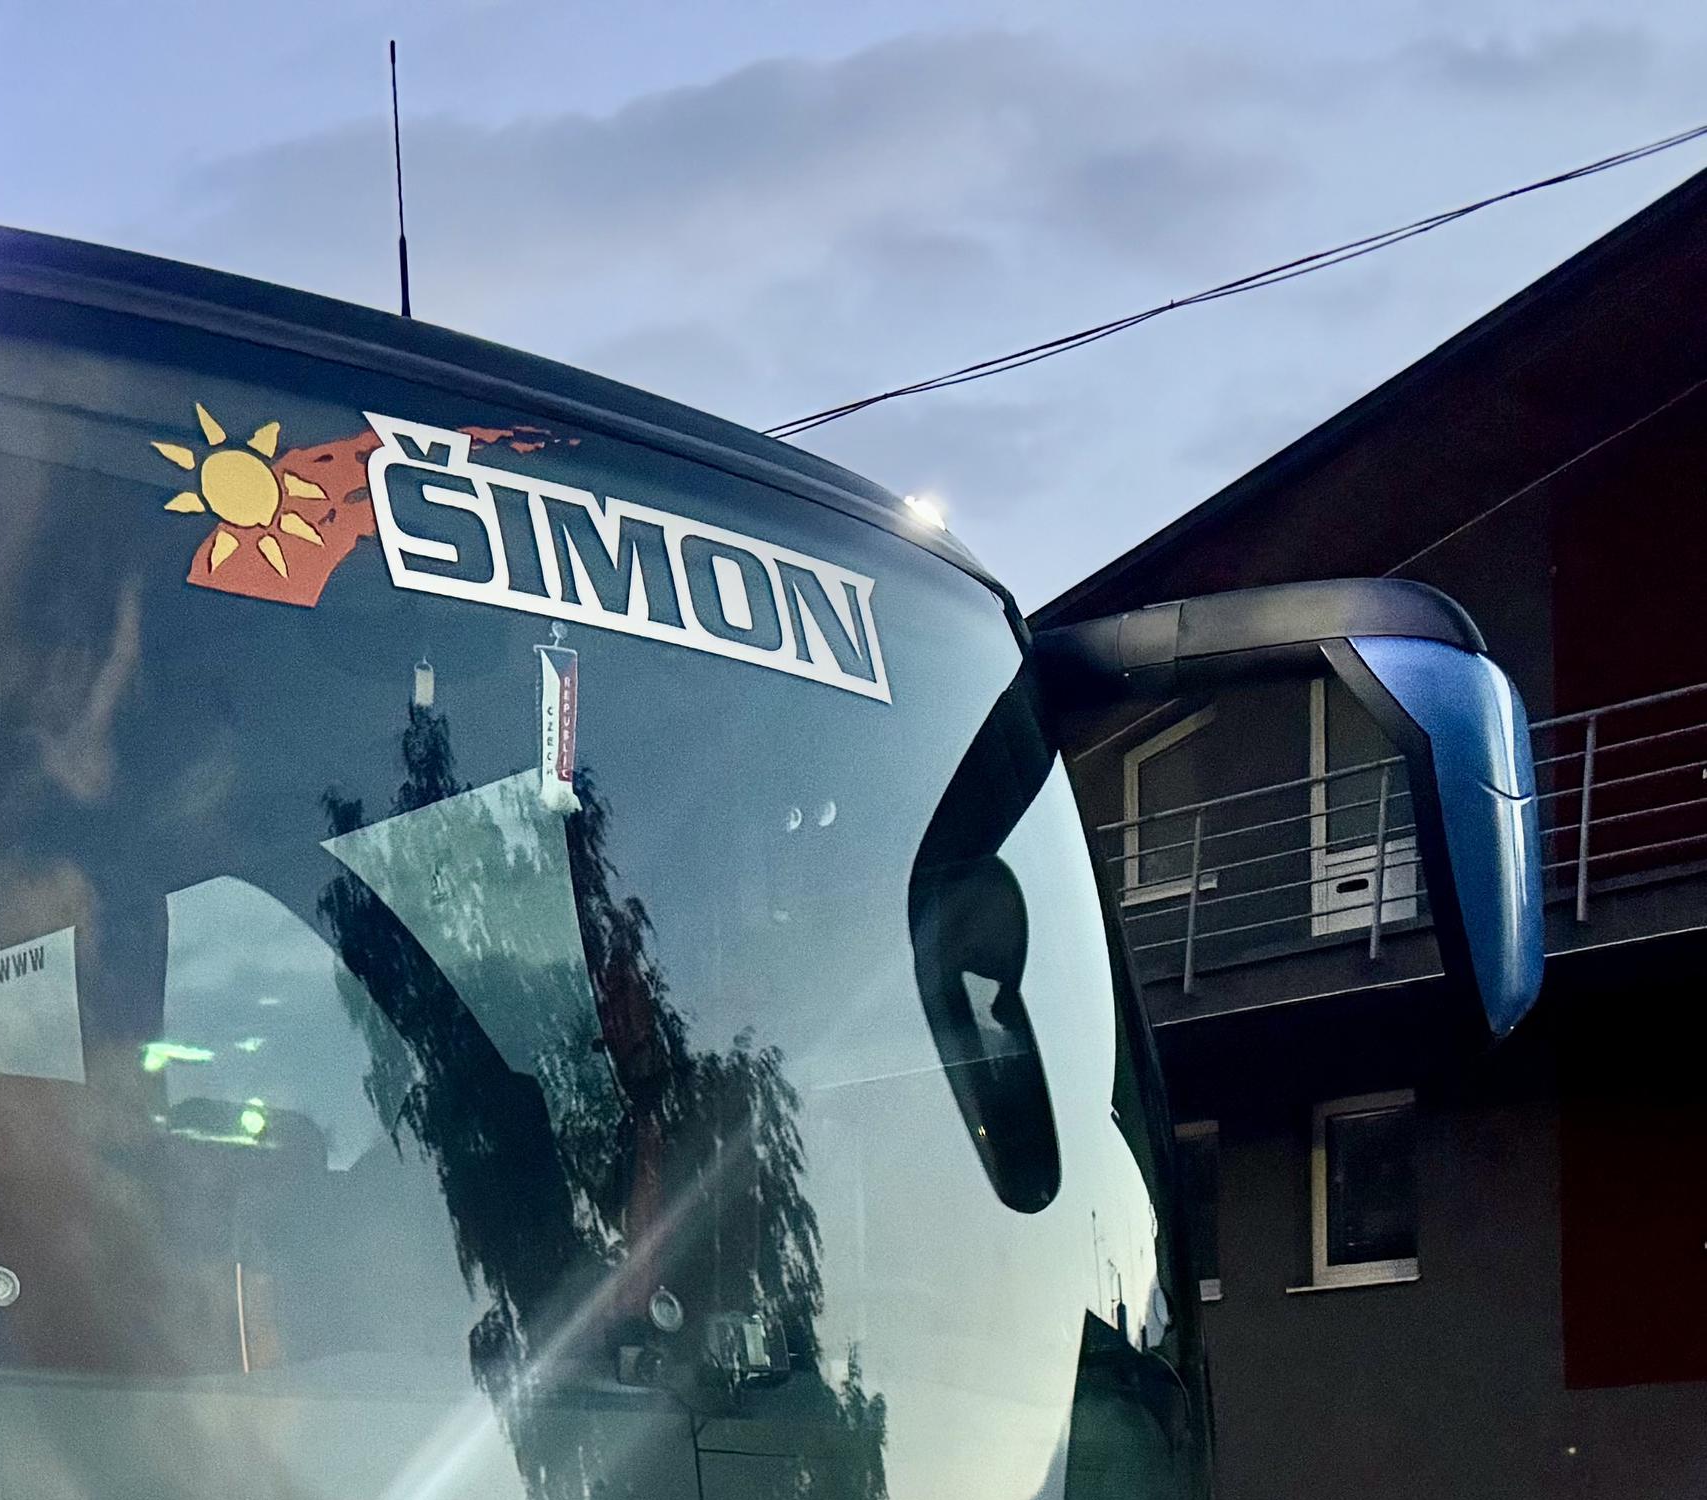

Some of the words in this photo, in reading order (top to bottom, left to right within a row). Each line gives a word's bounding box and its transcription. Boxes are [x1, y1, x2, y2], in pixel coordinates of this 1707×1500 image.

[382, 430, 878, 684] ŠIMON
[546, 706, 554, 777] CZECH
[561, 675, 573, 779] REPUBLIC
